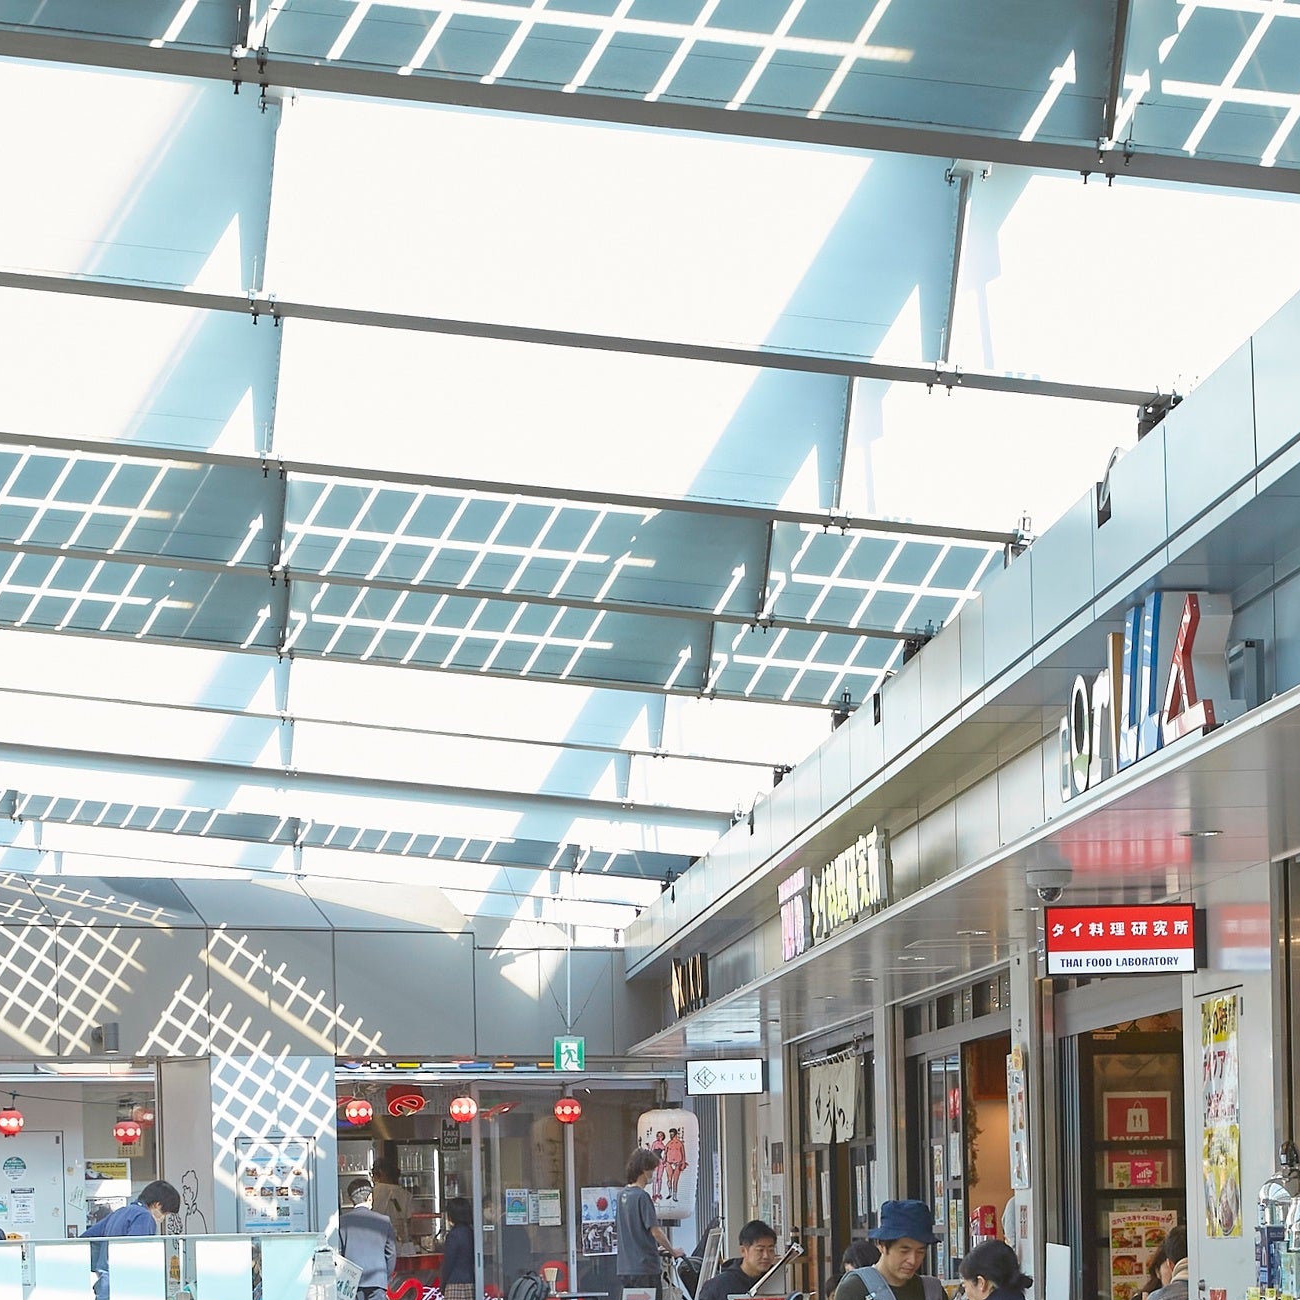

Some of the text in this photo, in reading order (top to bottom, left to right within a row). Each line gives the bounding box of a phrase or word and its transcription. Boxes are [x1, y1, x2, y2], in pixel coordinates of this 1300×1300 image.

[1052, 920, 1189, 937] タイ料理研究所
[1060, 956, 1179, 968] THAI FOOD LABORATORY
[720, 1072, 758, 1082] KIKU
